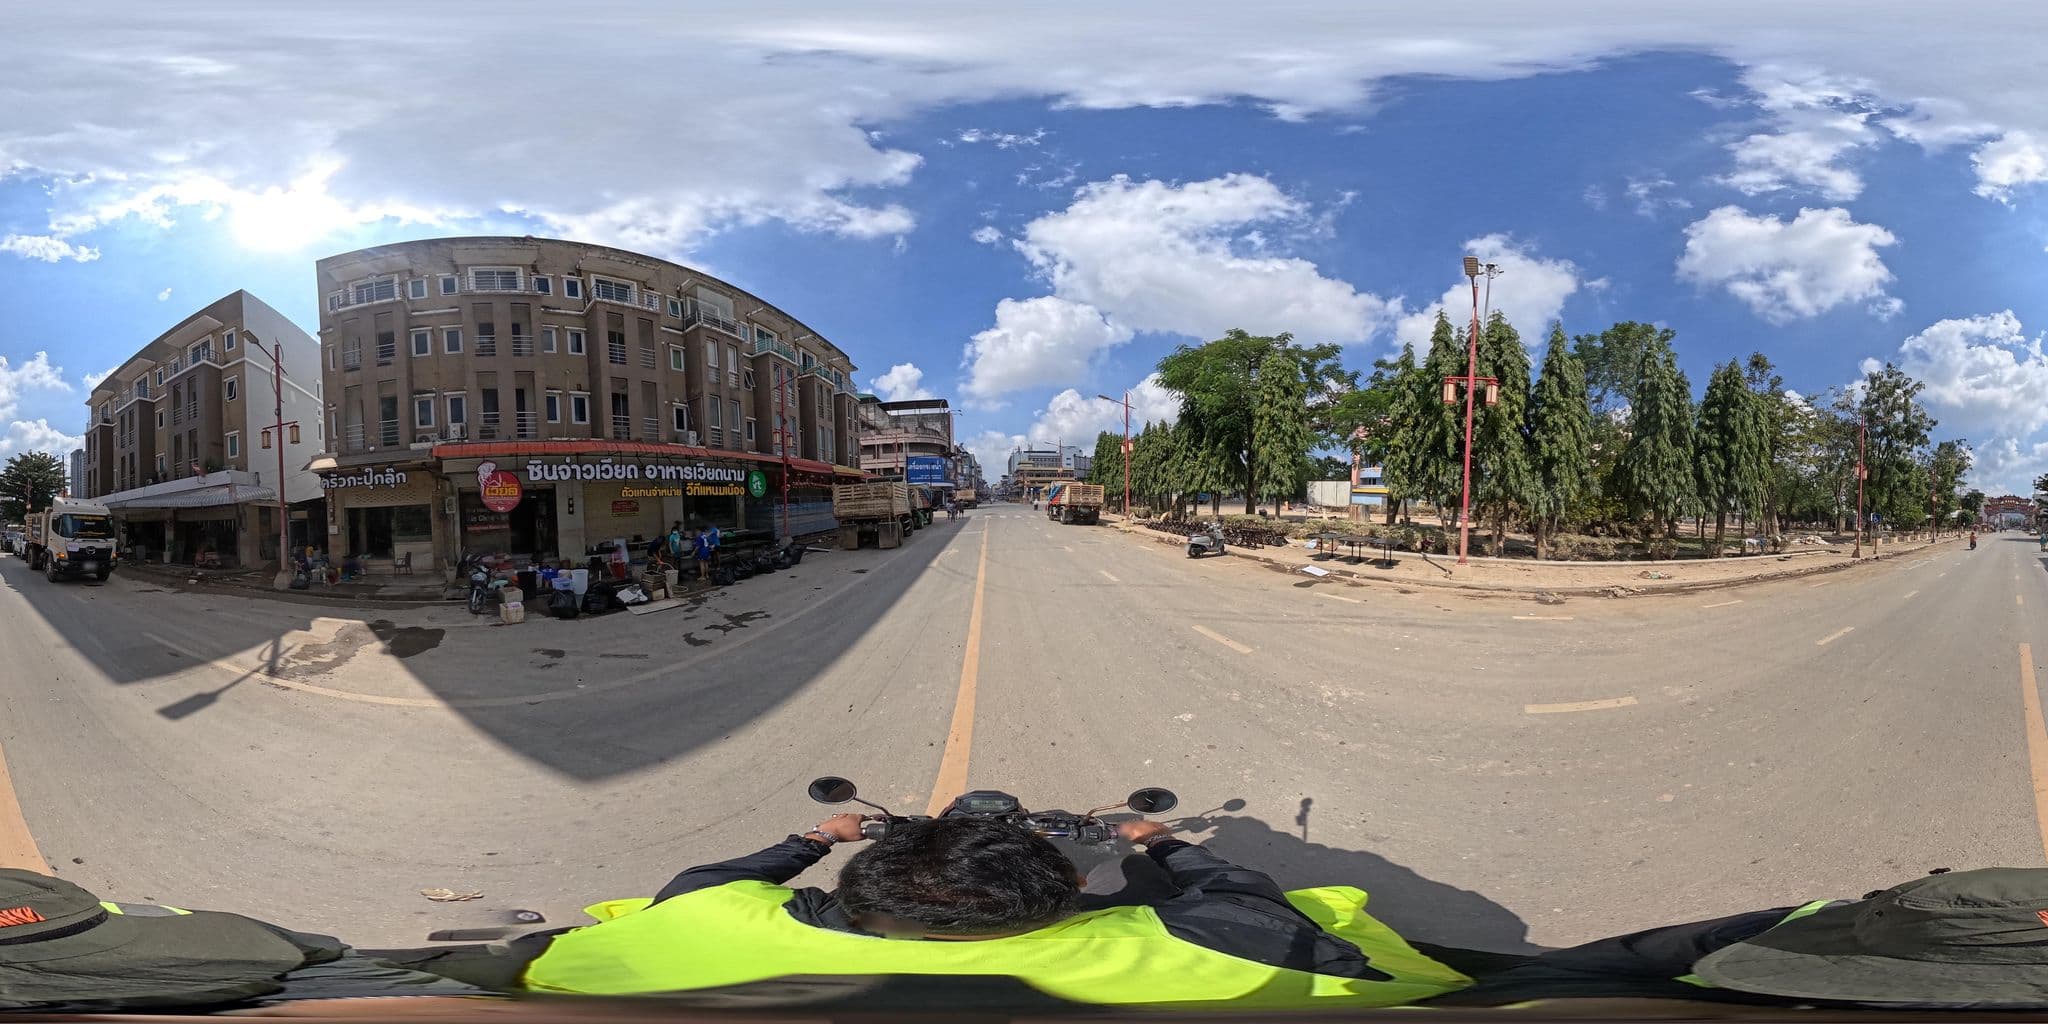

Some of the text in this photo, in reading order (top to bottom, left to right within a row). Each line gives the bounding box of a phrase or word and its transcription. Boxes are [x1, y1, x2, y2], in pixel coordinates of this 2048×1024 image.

[526, 456, 745, 482] ชินจ่าวเวียด อาหารเวียดนาม
[621, 486, 682, 497] ตัวแทนจำหน่าย
